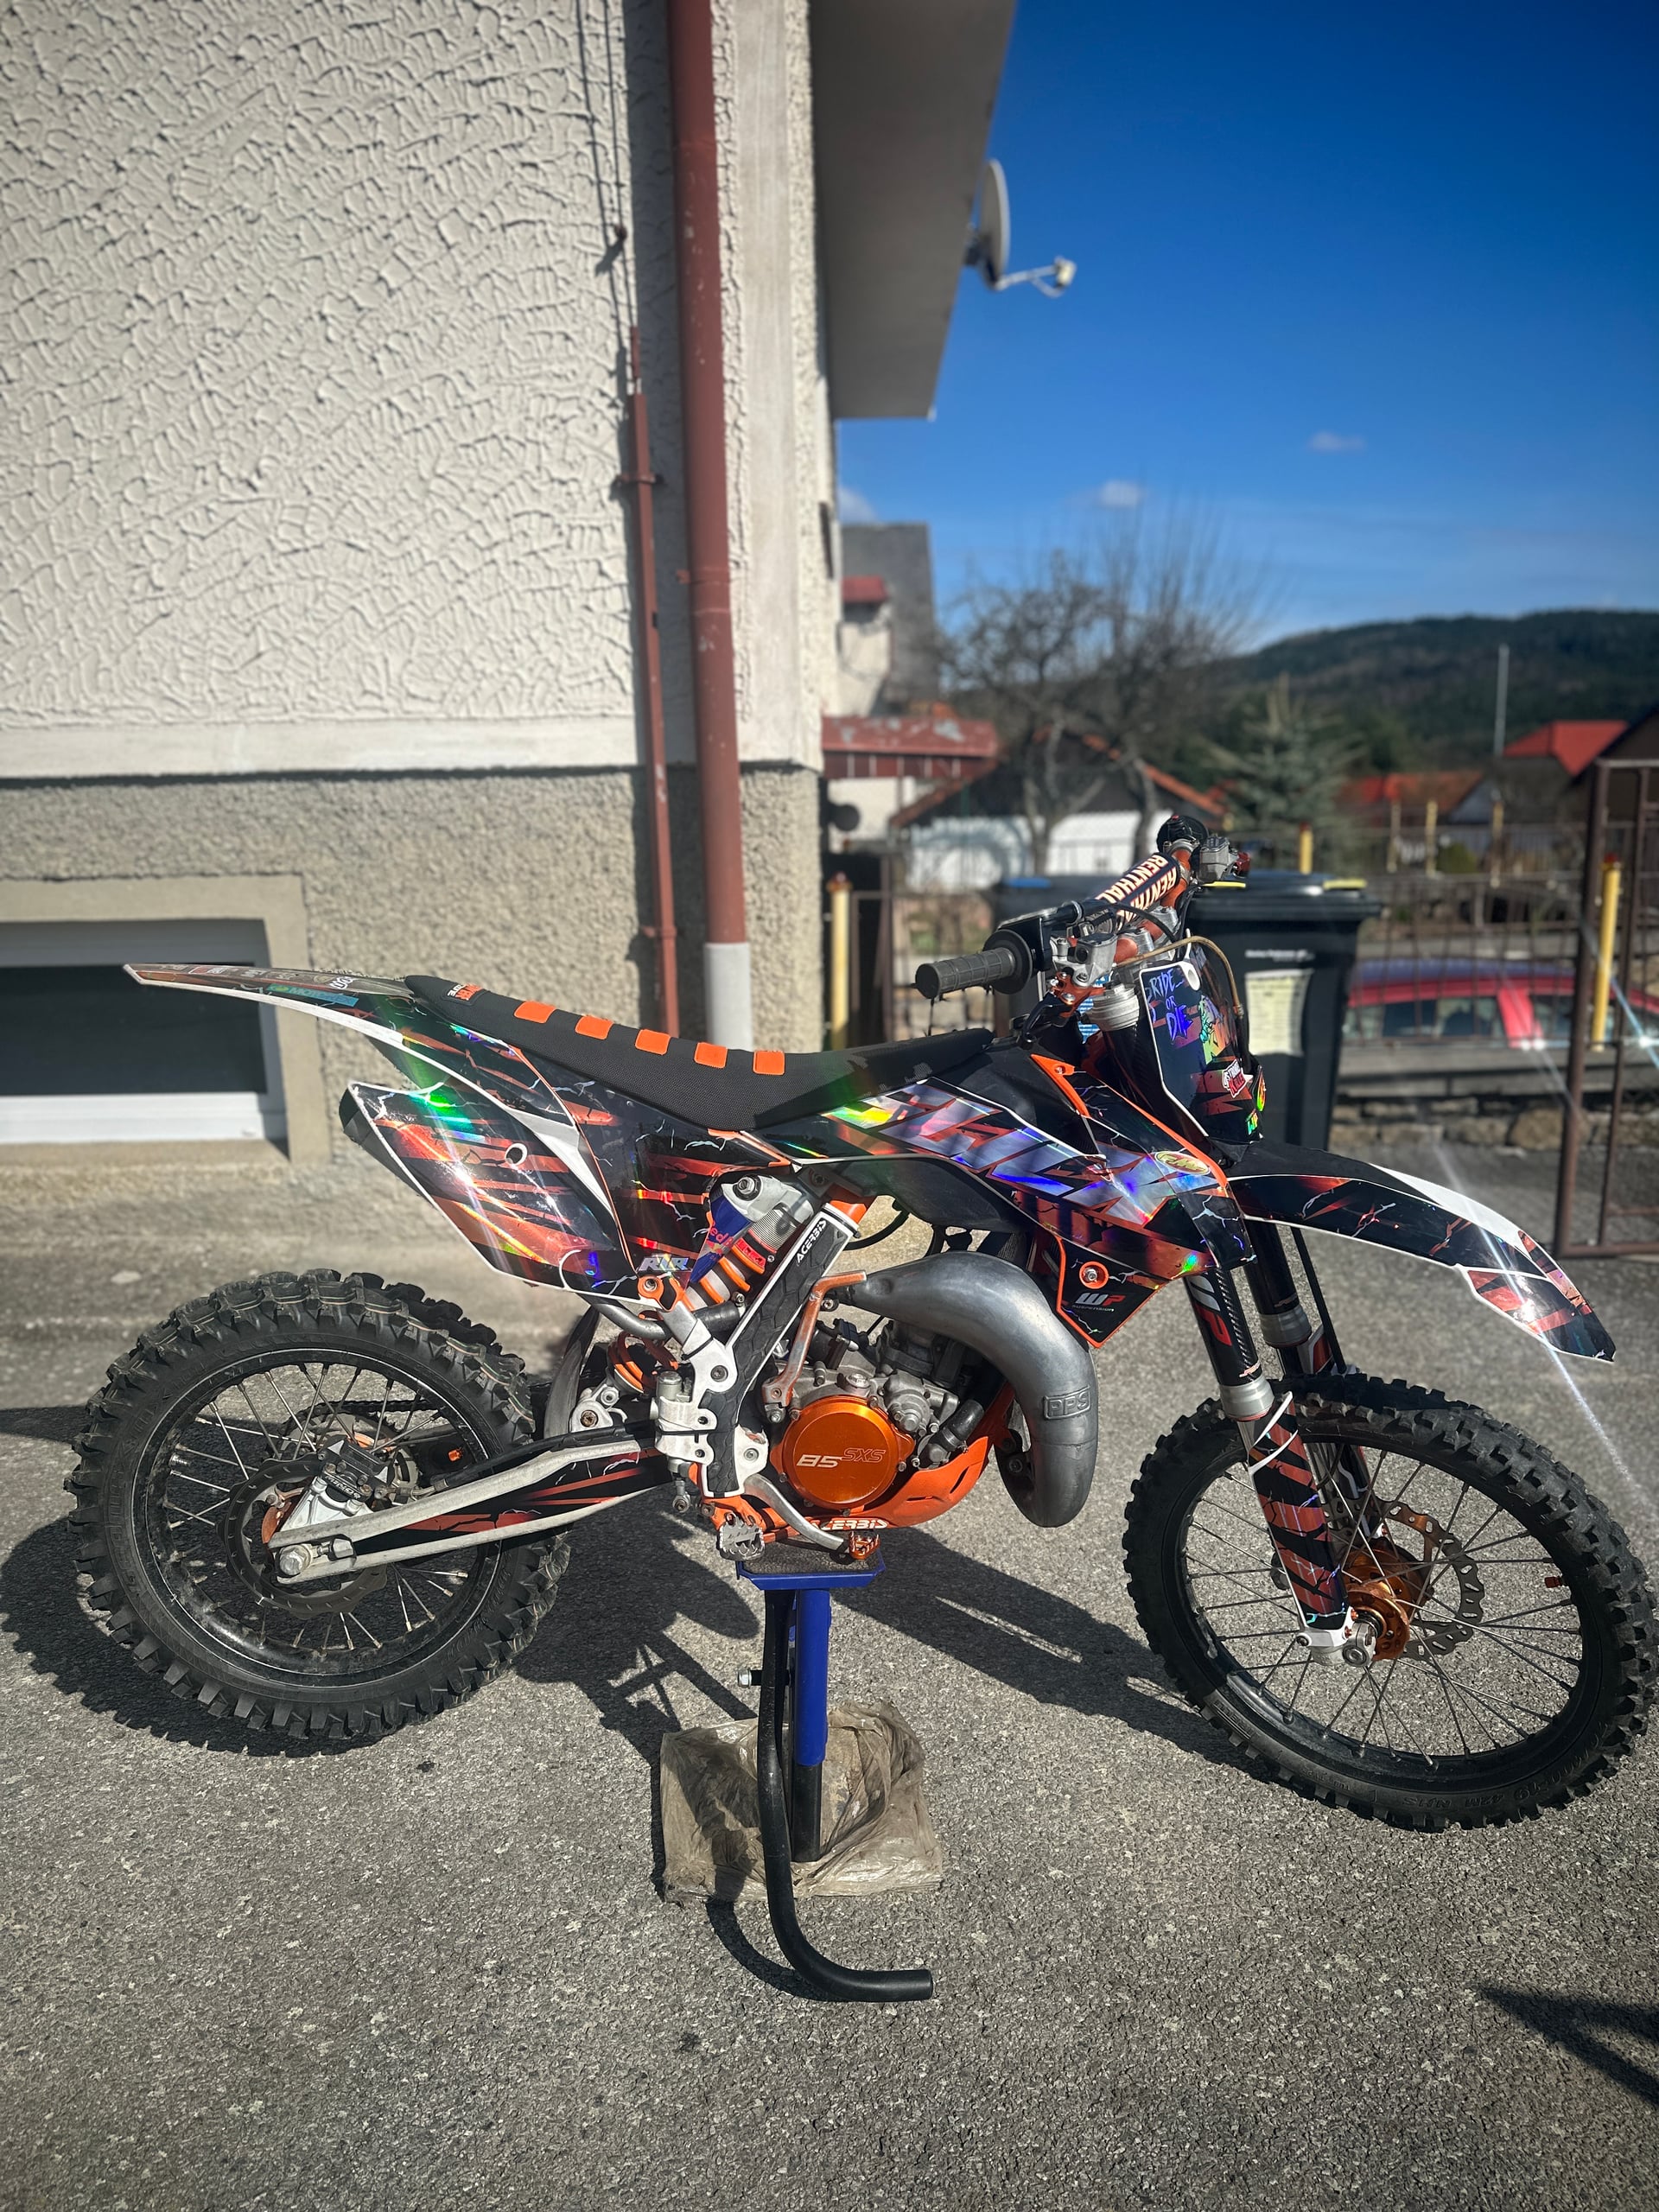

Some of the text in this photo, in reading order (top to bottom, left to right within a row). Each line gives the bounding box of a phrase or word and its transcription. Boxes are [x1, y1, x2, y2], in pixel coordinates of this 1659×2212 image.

[1095, 855, 1169, 904] RENTHAL
[1149, 969, 1175, 999] RIDE
[1166, 995, 1177, 1010] OR
[1166, 1004, 1193, 1041] DIE
[797, 1220, 827, 1262] ACERBIS
[1075, 1293, 1126, 1306] WP
[1048, 1391, 1088, 1416] PPS
[796, 1447, 886, 1468] 85 SXS
[811, 1519, 889, 1530] CERBIS
